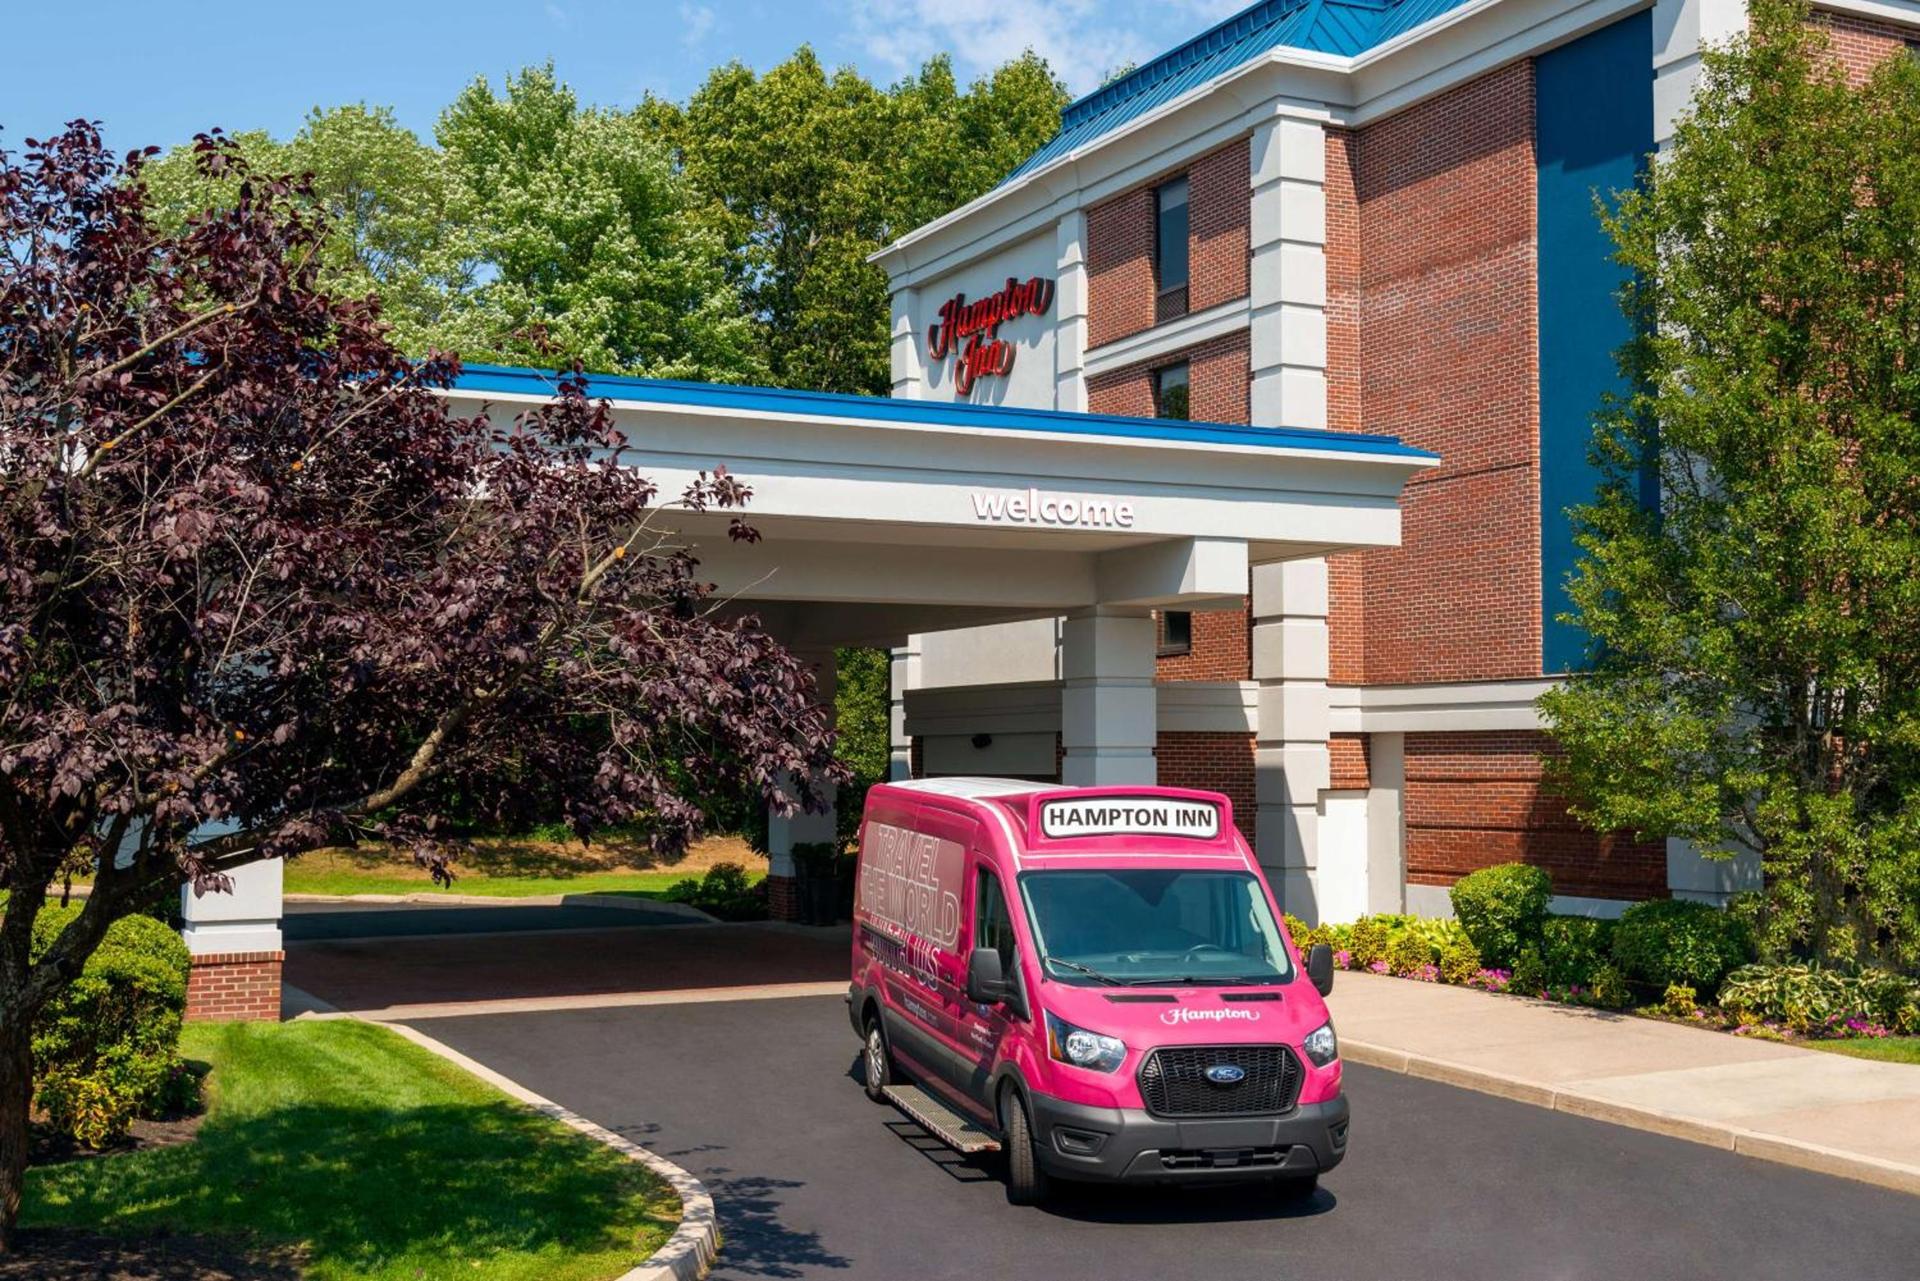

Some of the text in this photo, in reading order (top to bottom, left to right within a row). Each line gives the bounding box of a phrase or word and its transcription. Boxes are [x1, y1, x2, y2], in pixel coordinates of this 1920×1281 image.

[928, 277, 1054, 360] Hampton
[955, 334, 1016, 395] Inn
[971, 488, 1134, 527] welcome
[1050, 808, 1212, 827] HAMPTON INN
[877, 824, 941, 890] TRAVEL
[887, 872, 959, 946] WORLD
[1160, 1008, 1260, 1025] Hampton
